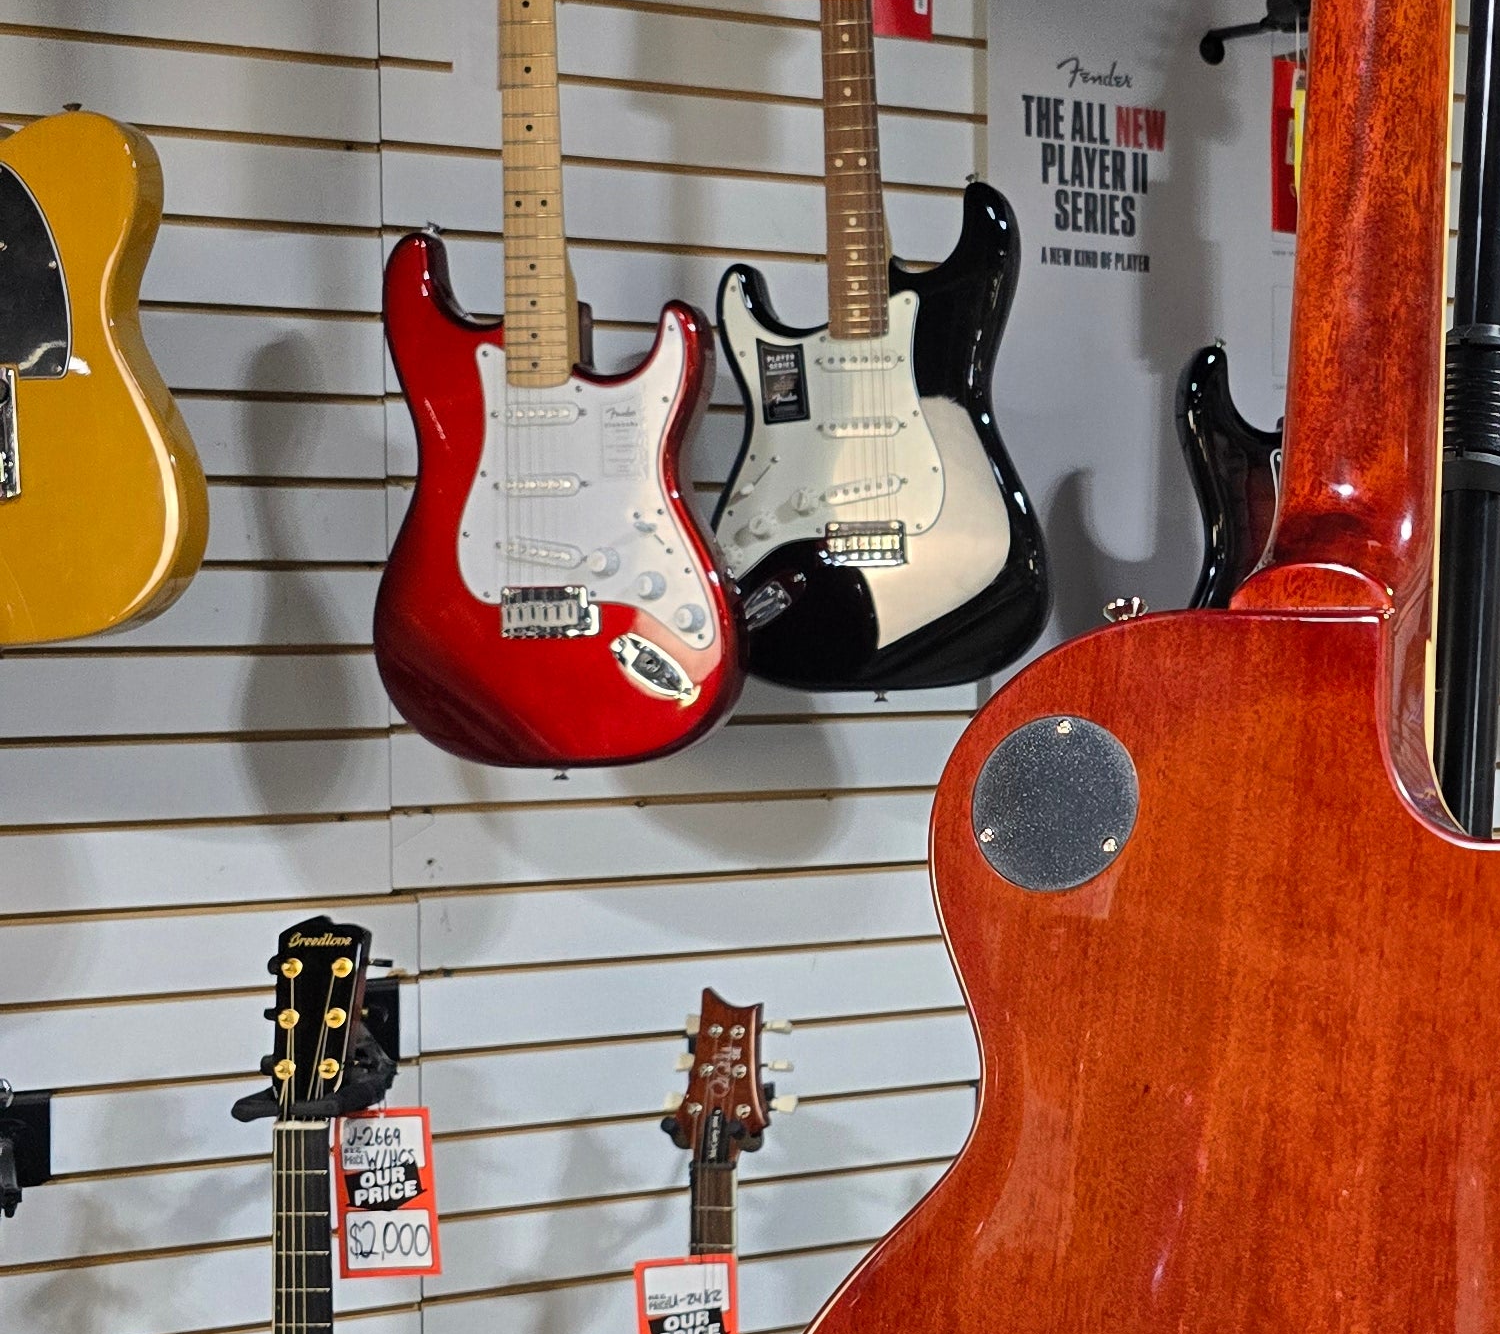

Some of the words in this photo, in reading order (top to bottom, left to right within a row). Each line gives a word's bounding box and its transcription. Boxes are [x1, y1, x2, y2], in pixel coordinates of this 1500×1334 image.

[1056, 56, 1134, 89] Fender
[1022, 94, 1064, 141] THE
[1071, 100, 1110, 146] ALL
[1115, 104, 1166, 152] NEW
[1041, 142, 1126, 192] PLAYER
[1132, 152, 1149, 195] II
[1054, 188, 1136, 238] SERIES
[1049, 247, 1073, 266] NEW
[1114, 252, 1151, 273] PLAYER
[354, 1179, 418, 1207] PRICE
[359, 1166, 406, 1189] OUR
[350, 1219, 431, 1261] $2,000
[663, 1310, 710, 1332] OUR
